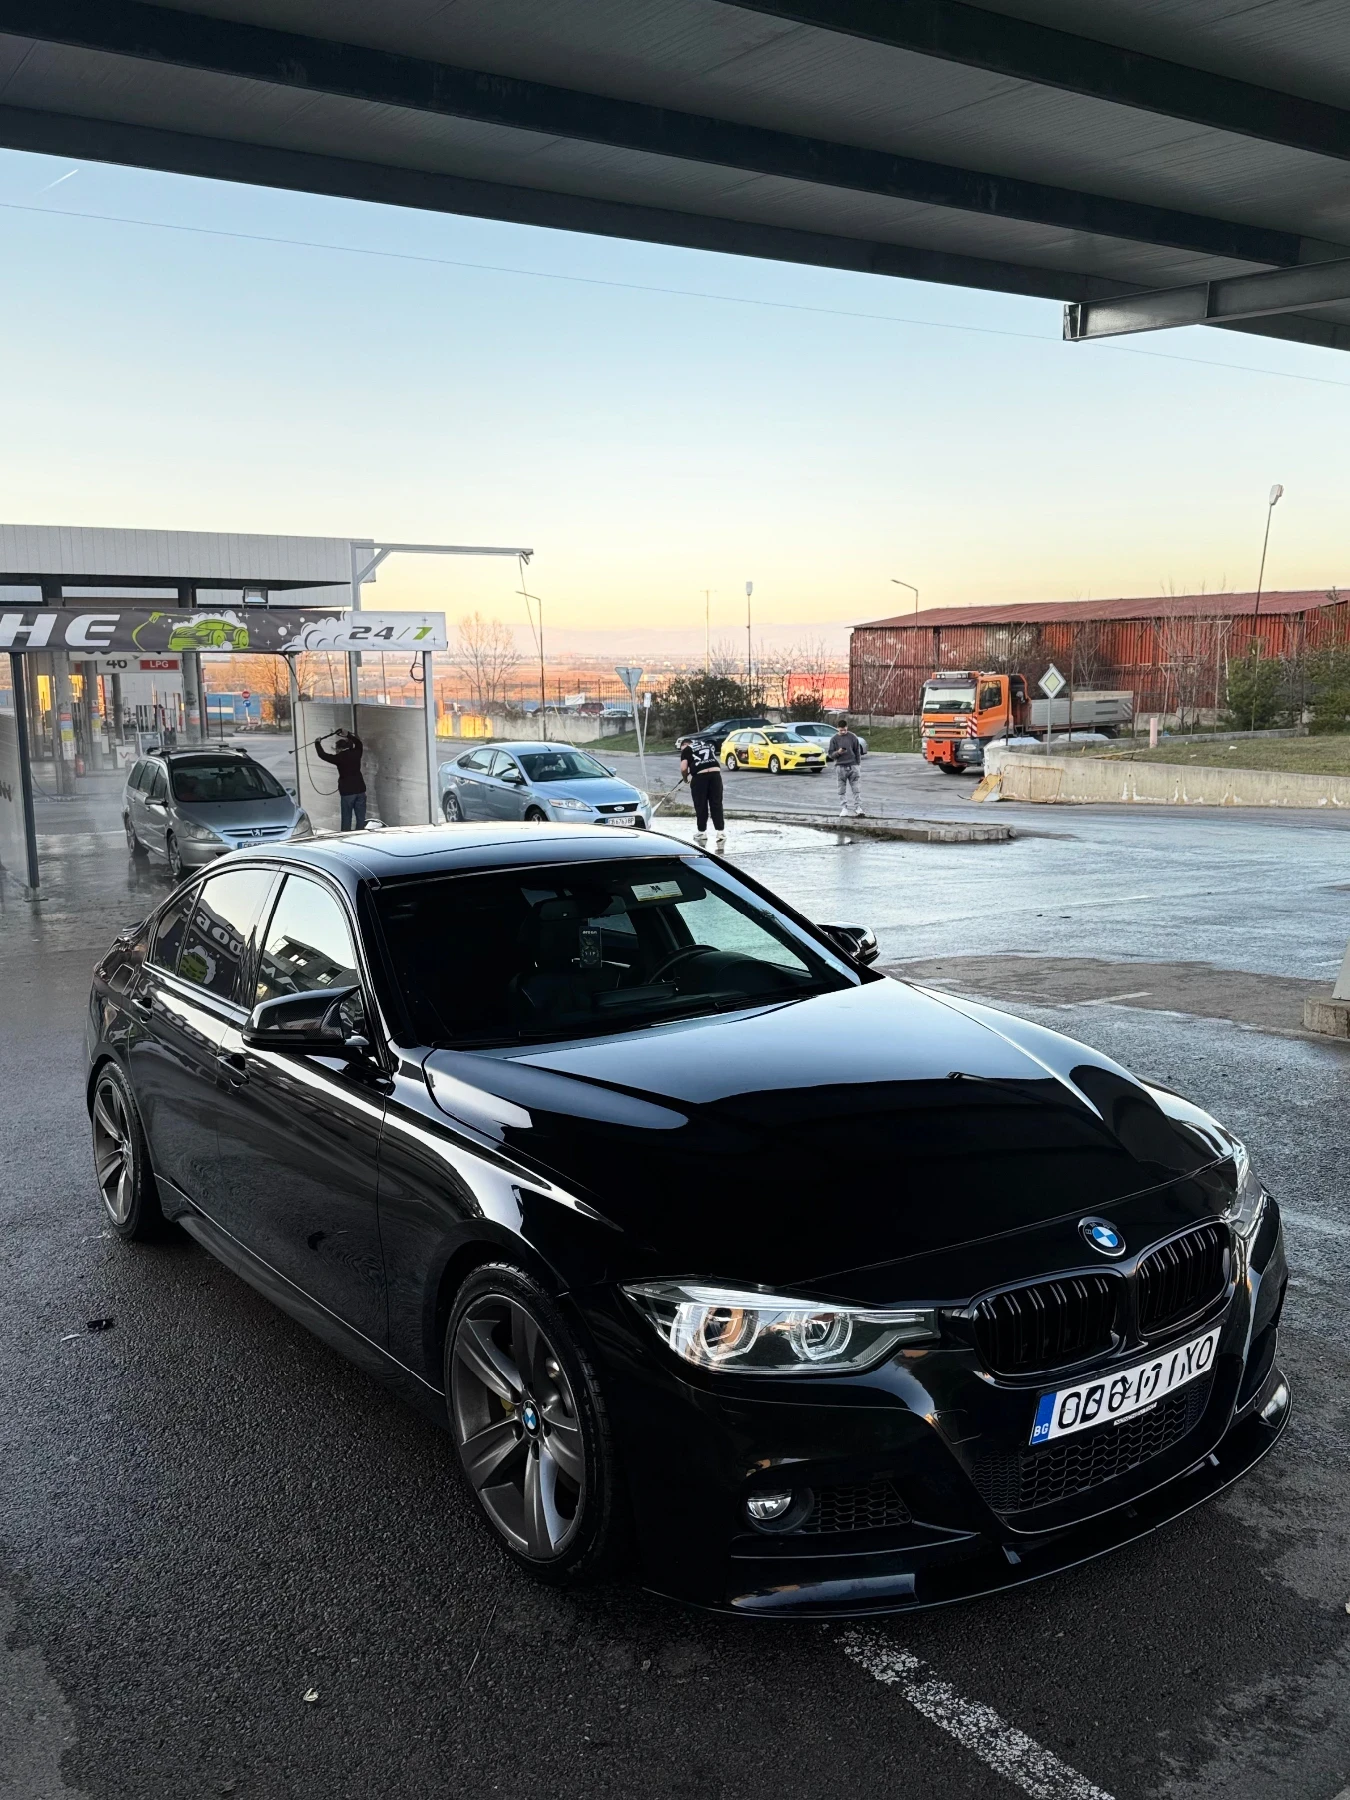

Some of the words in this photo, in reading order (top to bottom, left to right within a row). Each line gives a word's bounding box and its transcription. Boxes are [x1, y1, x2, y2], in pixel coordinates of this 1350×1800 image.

[349, 625, 433, 641] 24/7
[149, 660, 169, 668] LPG
[699, 748, 710, 760] 7
[1033, 1422, 1050, 1438] BG
